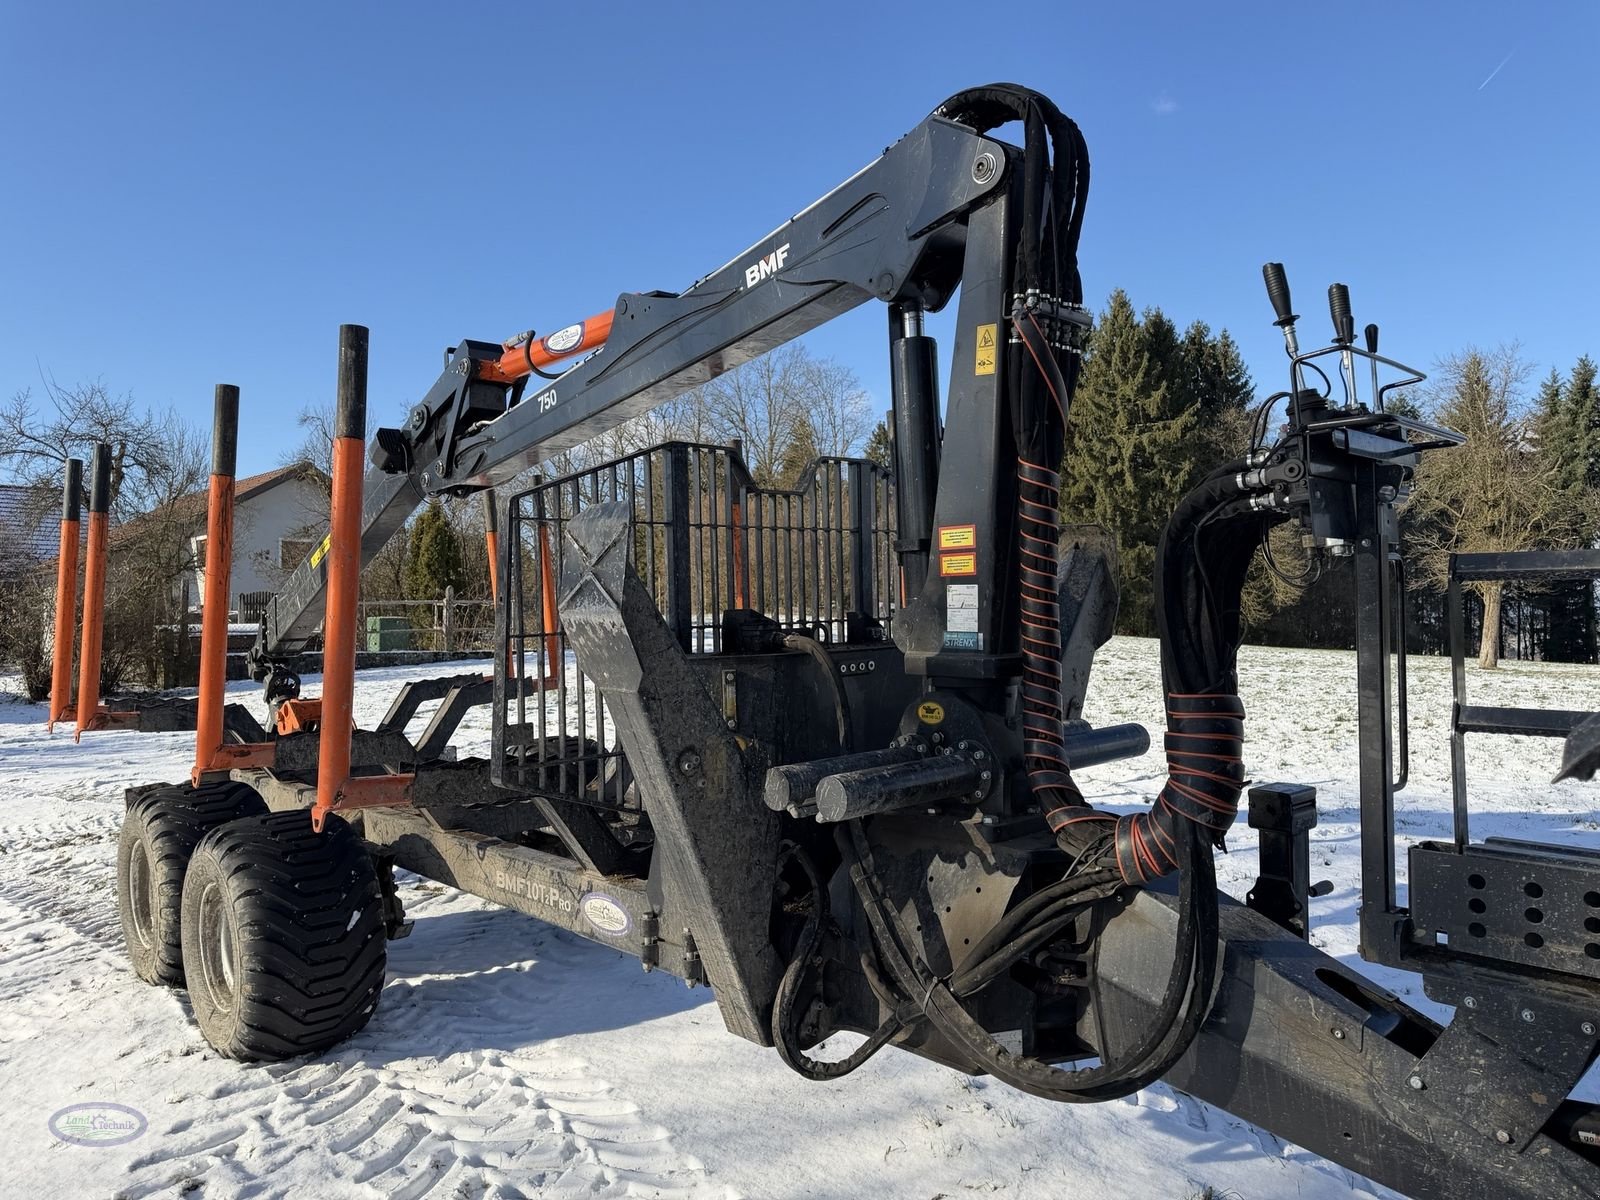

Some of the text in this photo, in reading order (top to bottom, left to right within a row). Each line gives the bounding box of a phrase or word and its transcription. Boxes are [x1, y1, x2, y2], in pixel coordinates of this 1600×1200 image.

[745, 242, 790, 289] BMF
[537, 388, 557, 414] 750
[944, 638, 974, 648] STRENX
